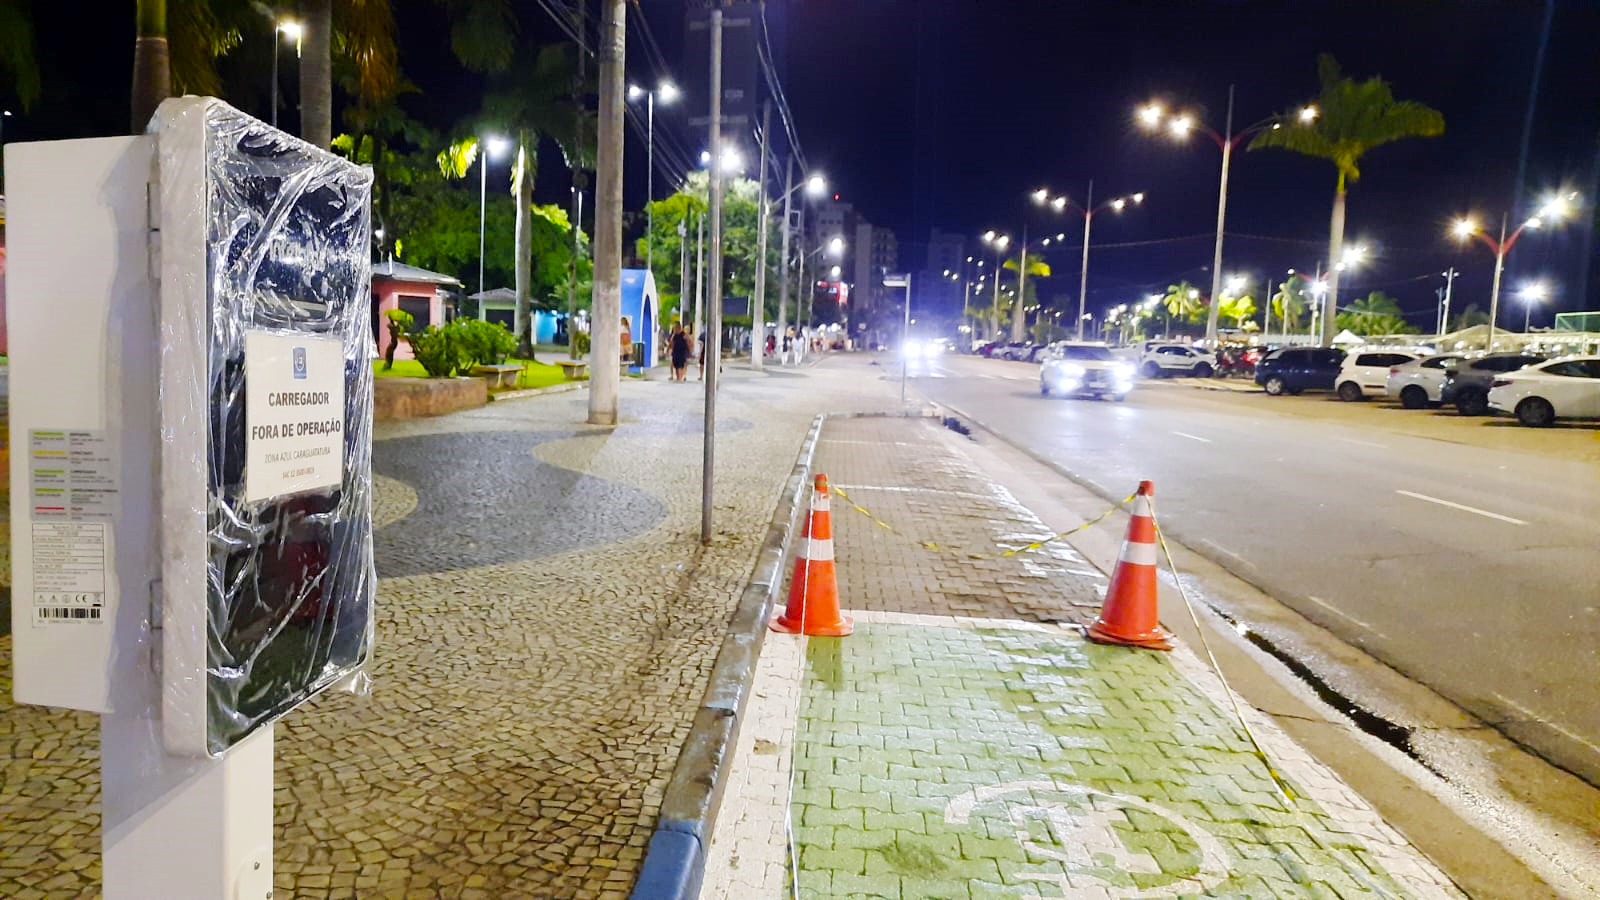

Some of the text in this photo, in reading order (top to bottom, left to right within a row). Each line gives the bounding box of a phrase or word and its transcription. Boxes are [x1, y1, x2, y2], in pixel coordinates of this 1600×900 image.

[268, 392, 329, 406] CARREGADOR
[252, 417, 341, 440] FORA DE OPERAÇÃO
[265, 451, 279, 464] ZONA
[280, 451, 292, 462] AZUL
